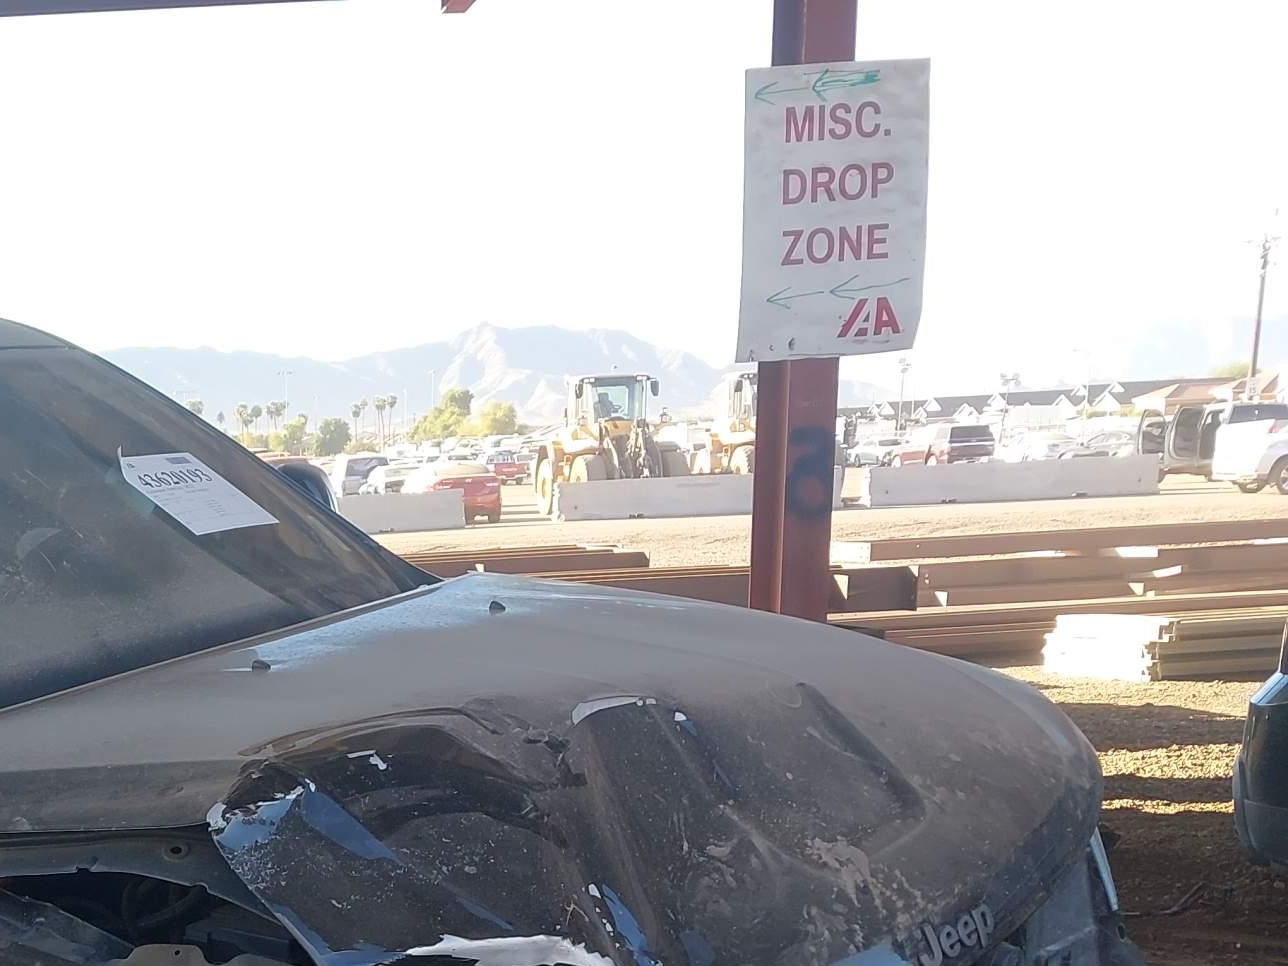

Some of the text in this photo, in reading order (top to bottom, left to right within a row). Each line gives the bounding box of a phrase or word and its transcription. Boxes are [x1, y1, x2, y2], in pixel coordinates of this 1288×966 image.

[785, 101, 892, 143] MISC.
[782, 162, 895, 205] DROP
[780, 223, 890, 266] ZONE
[137, 468, 213, 488] 43620193
